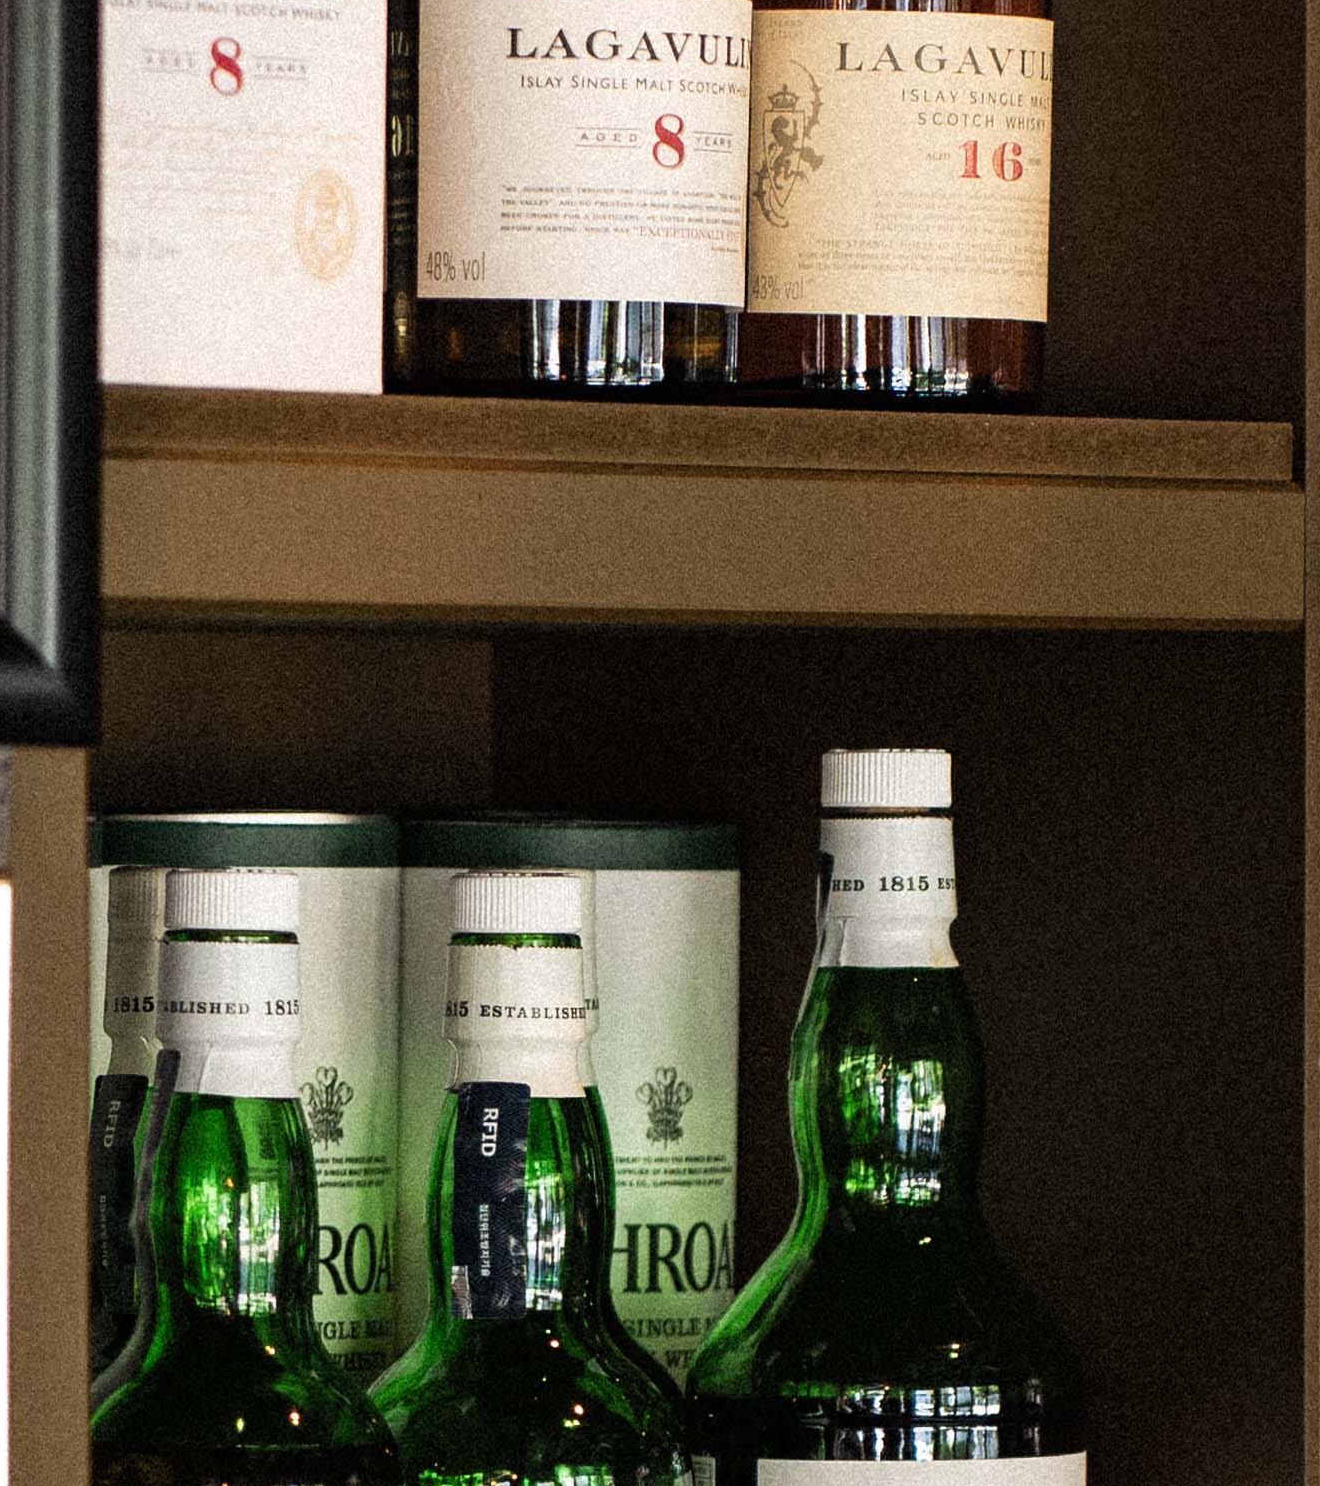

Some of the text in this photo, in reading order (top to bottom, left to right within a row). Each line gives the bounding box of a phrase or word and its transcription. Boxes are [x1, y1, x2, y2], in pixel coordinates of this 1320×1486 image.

[210, 37, 243, 96] 8
[520, 74, 726, 95] ISLAY SINGLE MALT SCOTCH
[902, 90, 1024, 106] ISLAY SINGLE
[918, 112, 1046, 131] SCOTCH WHISKY
[581, 132, 639, 143] AGED
[652, 113, 685, 168] 8
[960, 140, 1024, 182] 16
[426, 251, 485, 282] 48% vol
[753, 274, 804, 300] 43% vol
[879, 876, 930, 892] 1815
[265, 1000, 299, 1015] 1815
[103, 1100, 121, 1148] RFID
[481, 1107, 499, 1157] RFID
